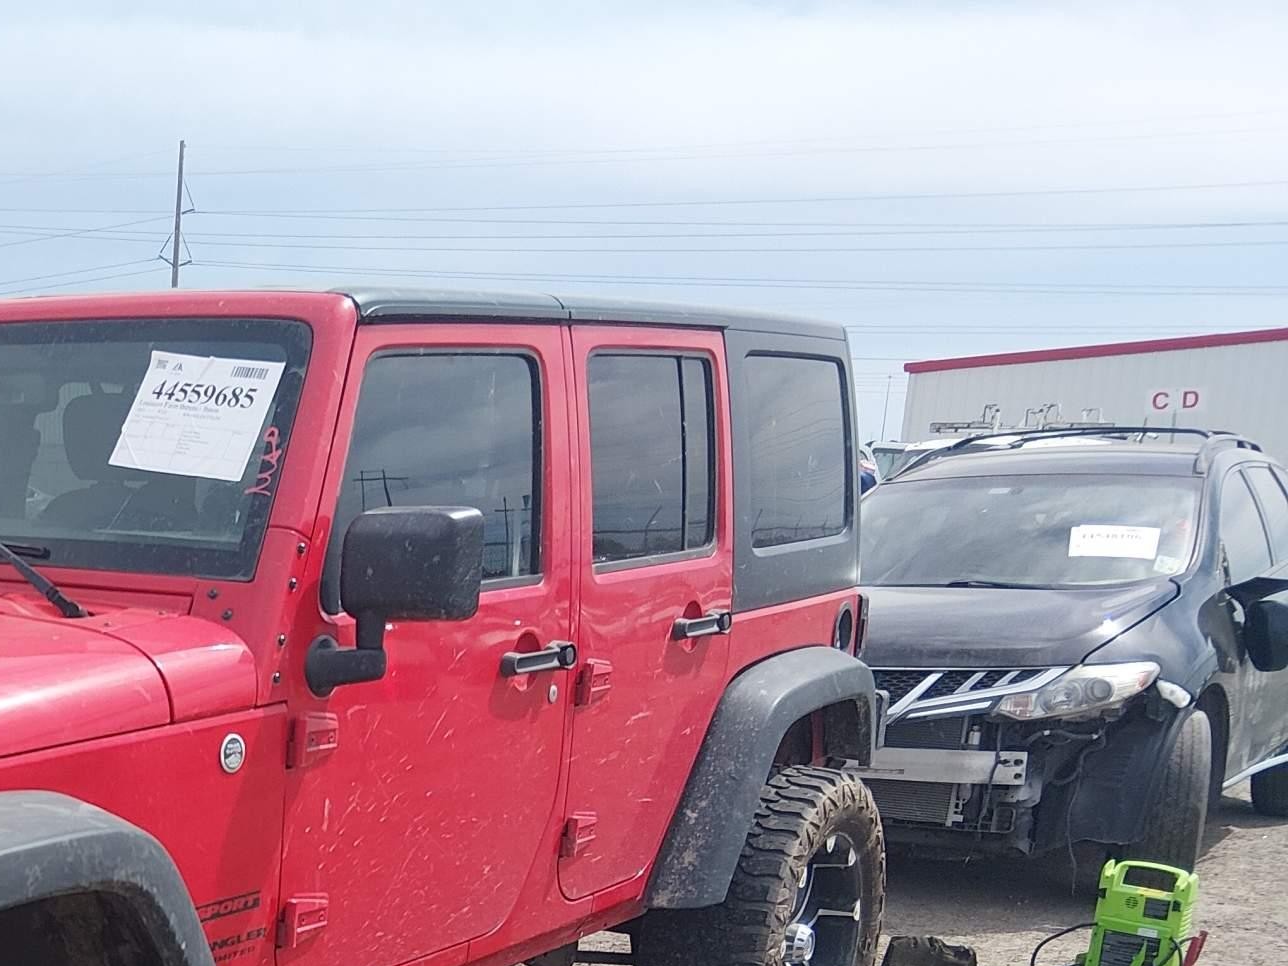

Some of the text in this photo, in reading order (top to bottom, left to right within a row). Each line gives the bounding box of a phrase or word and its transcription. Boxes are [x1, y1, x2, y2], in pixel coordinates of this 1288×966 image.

[152, 379, 258, 409] 44559685
[1152, 392, 1169, 410] C
[1182, 391, 1199, 408] D
